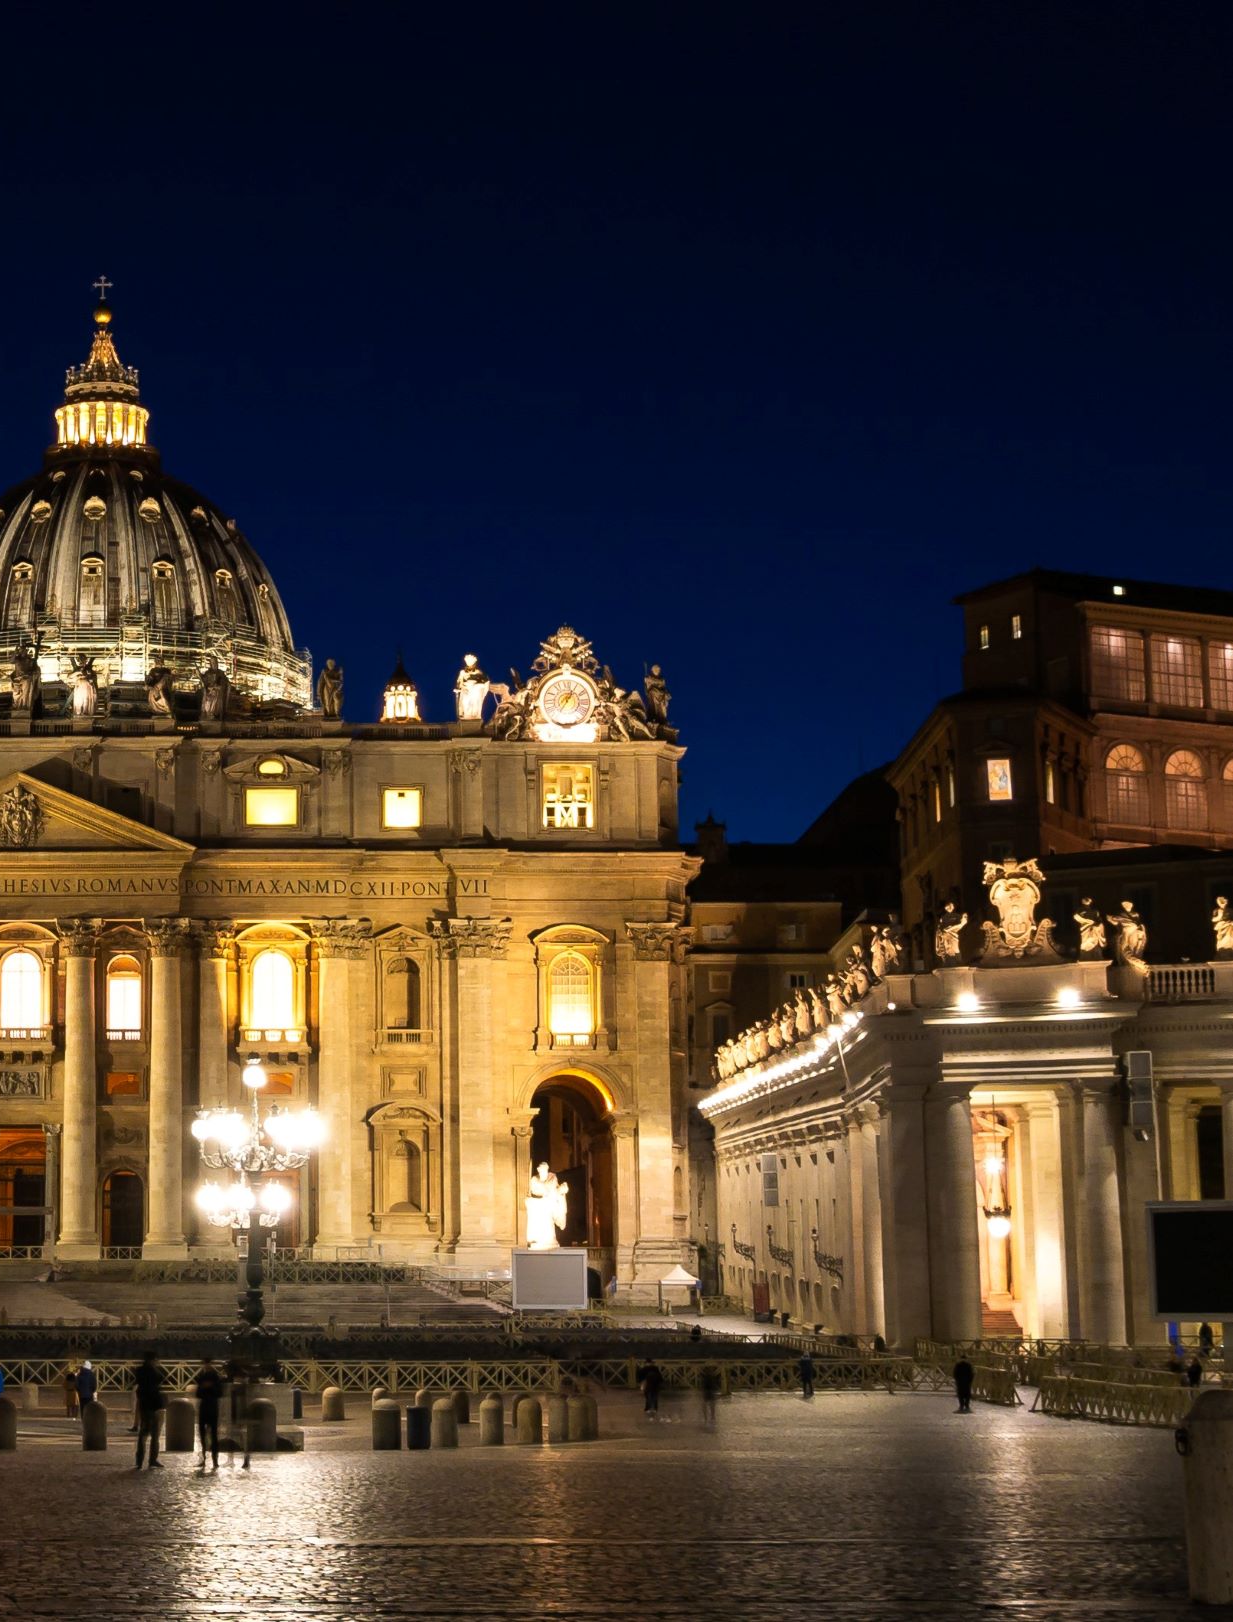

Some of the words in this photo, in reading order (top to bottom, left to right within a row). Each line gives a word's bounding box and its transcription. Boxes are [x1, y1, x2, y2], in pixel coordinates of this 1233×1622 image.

[77, 878, 178, 893] ROMANVS
[185, 879, 236, 894] PONT
[238, 879, 281, 894] MAX
[284, 879, 310, 894] AN
[315, 879, 394, 897] MDCXII
[460, 879, 488, 893] VII
